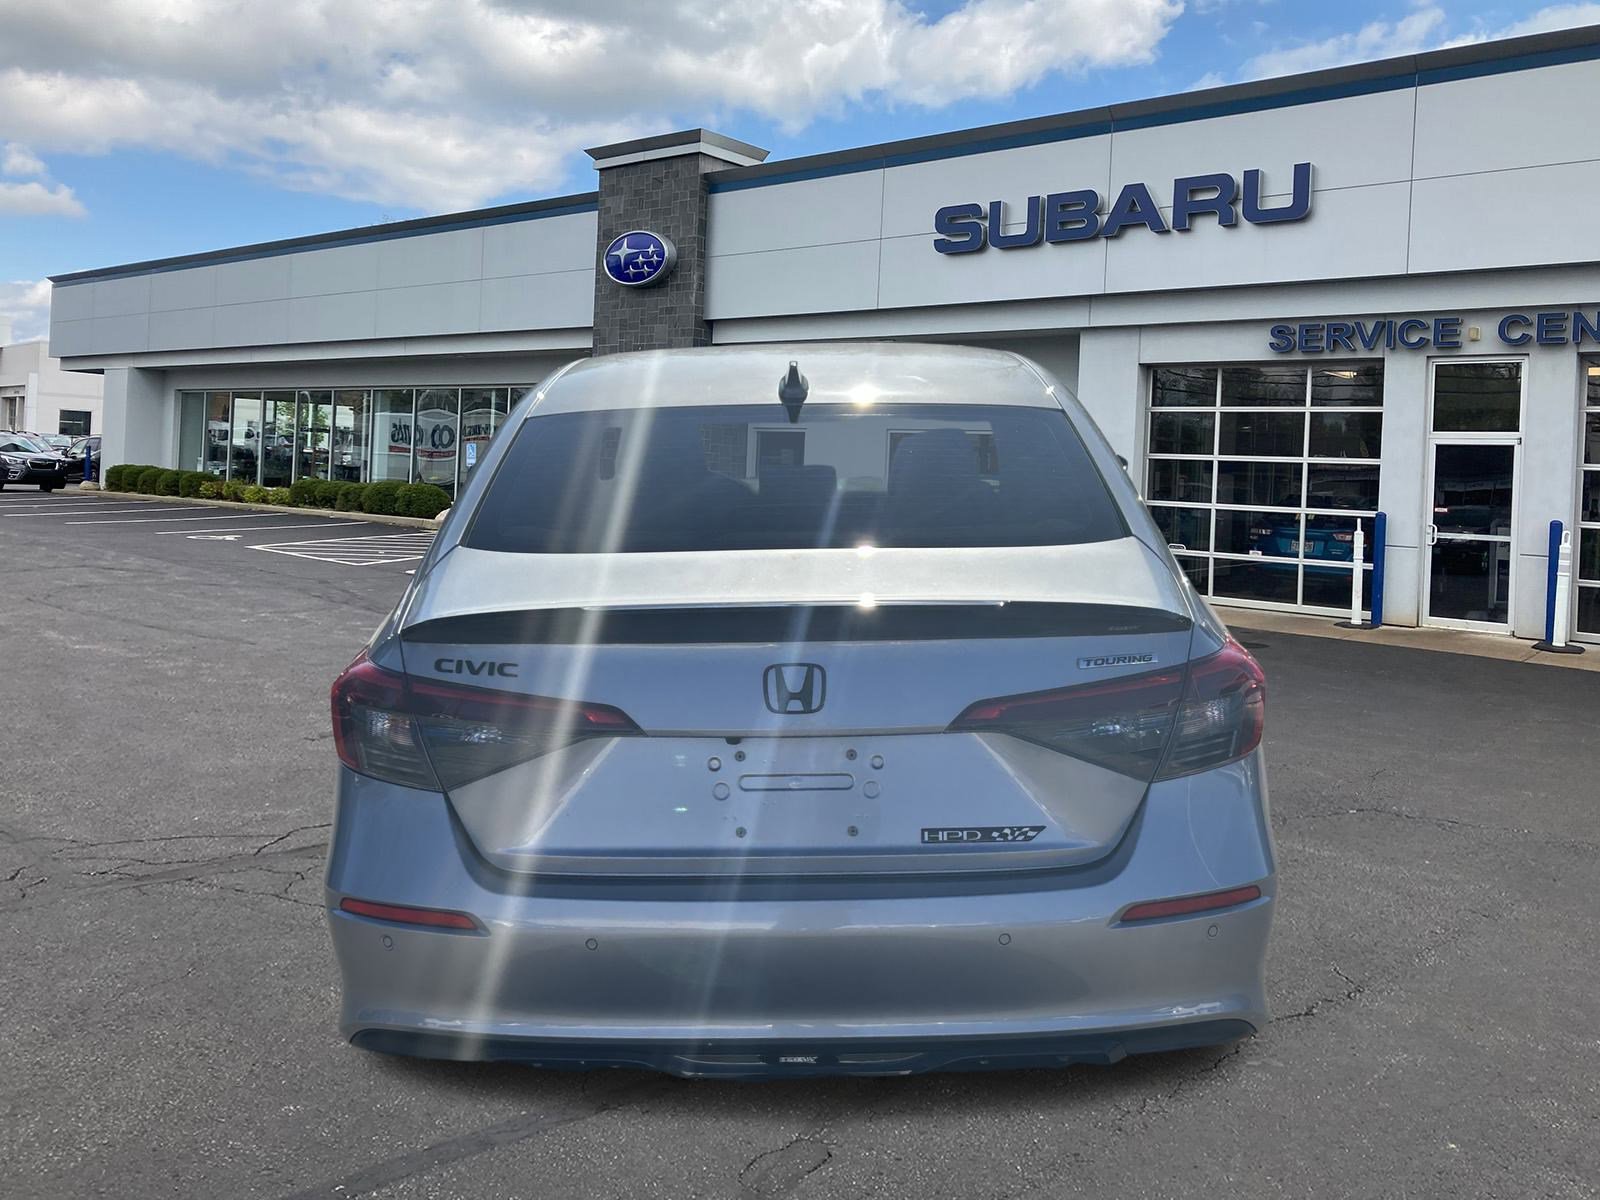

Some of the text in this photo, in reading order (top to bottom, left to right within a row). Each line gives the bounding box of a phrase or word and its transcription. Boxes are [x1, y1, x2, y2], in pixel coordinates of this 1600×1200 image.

[933, 162, 1313, 255] SUBARU
[1268, 311, 1600, 353] SERVICE CEN
[434, 658, 519, 678] CIVIC
[1082, 654, 1153, 667] TOURING
[923, 830, 982, 842] HPD
